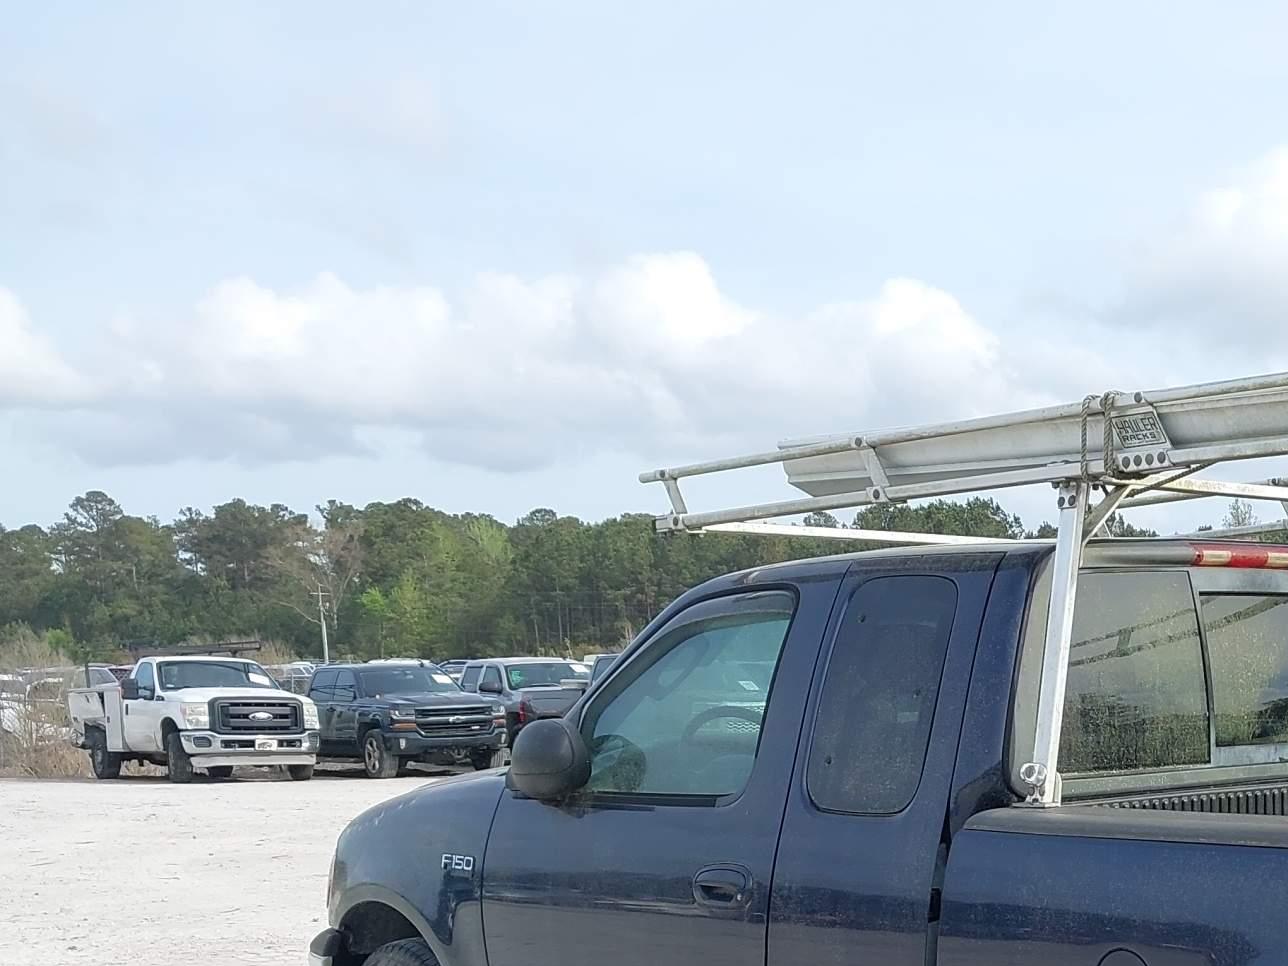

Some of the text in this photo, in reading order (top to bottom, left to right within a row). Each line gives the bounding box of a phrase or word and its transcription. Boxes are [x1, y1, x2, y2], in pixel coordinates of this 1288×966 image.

[1115, 416, 1158, 435] HAULER
[1121, 432, 1157, 442] RACKS
[441, 853, 474, 871] F150
